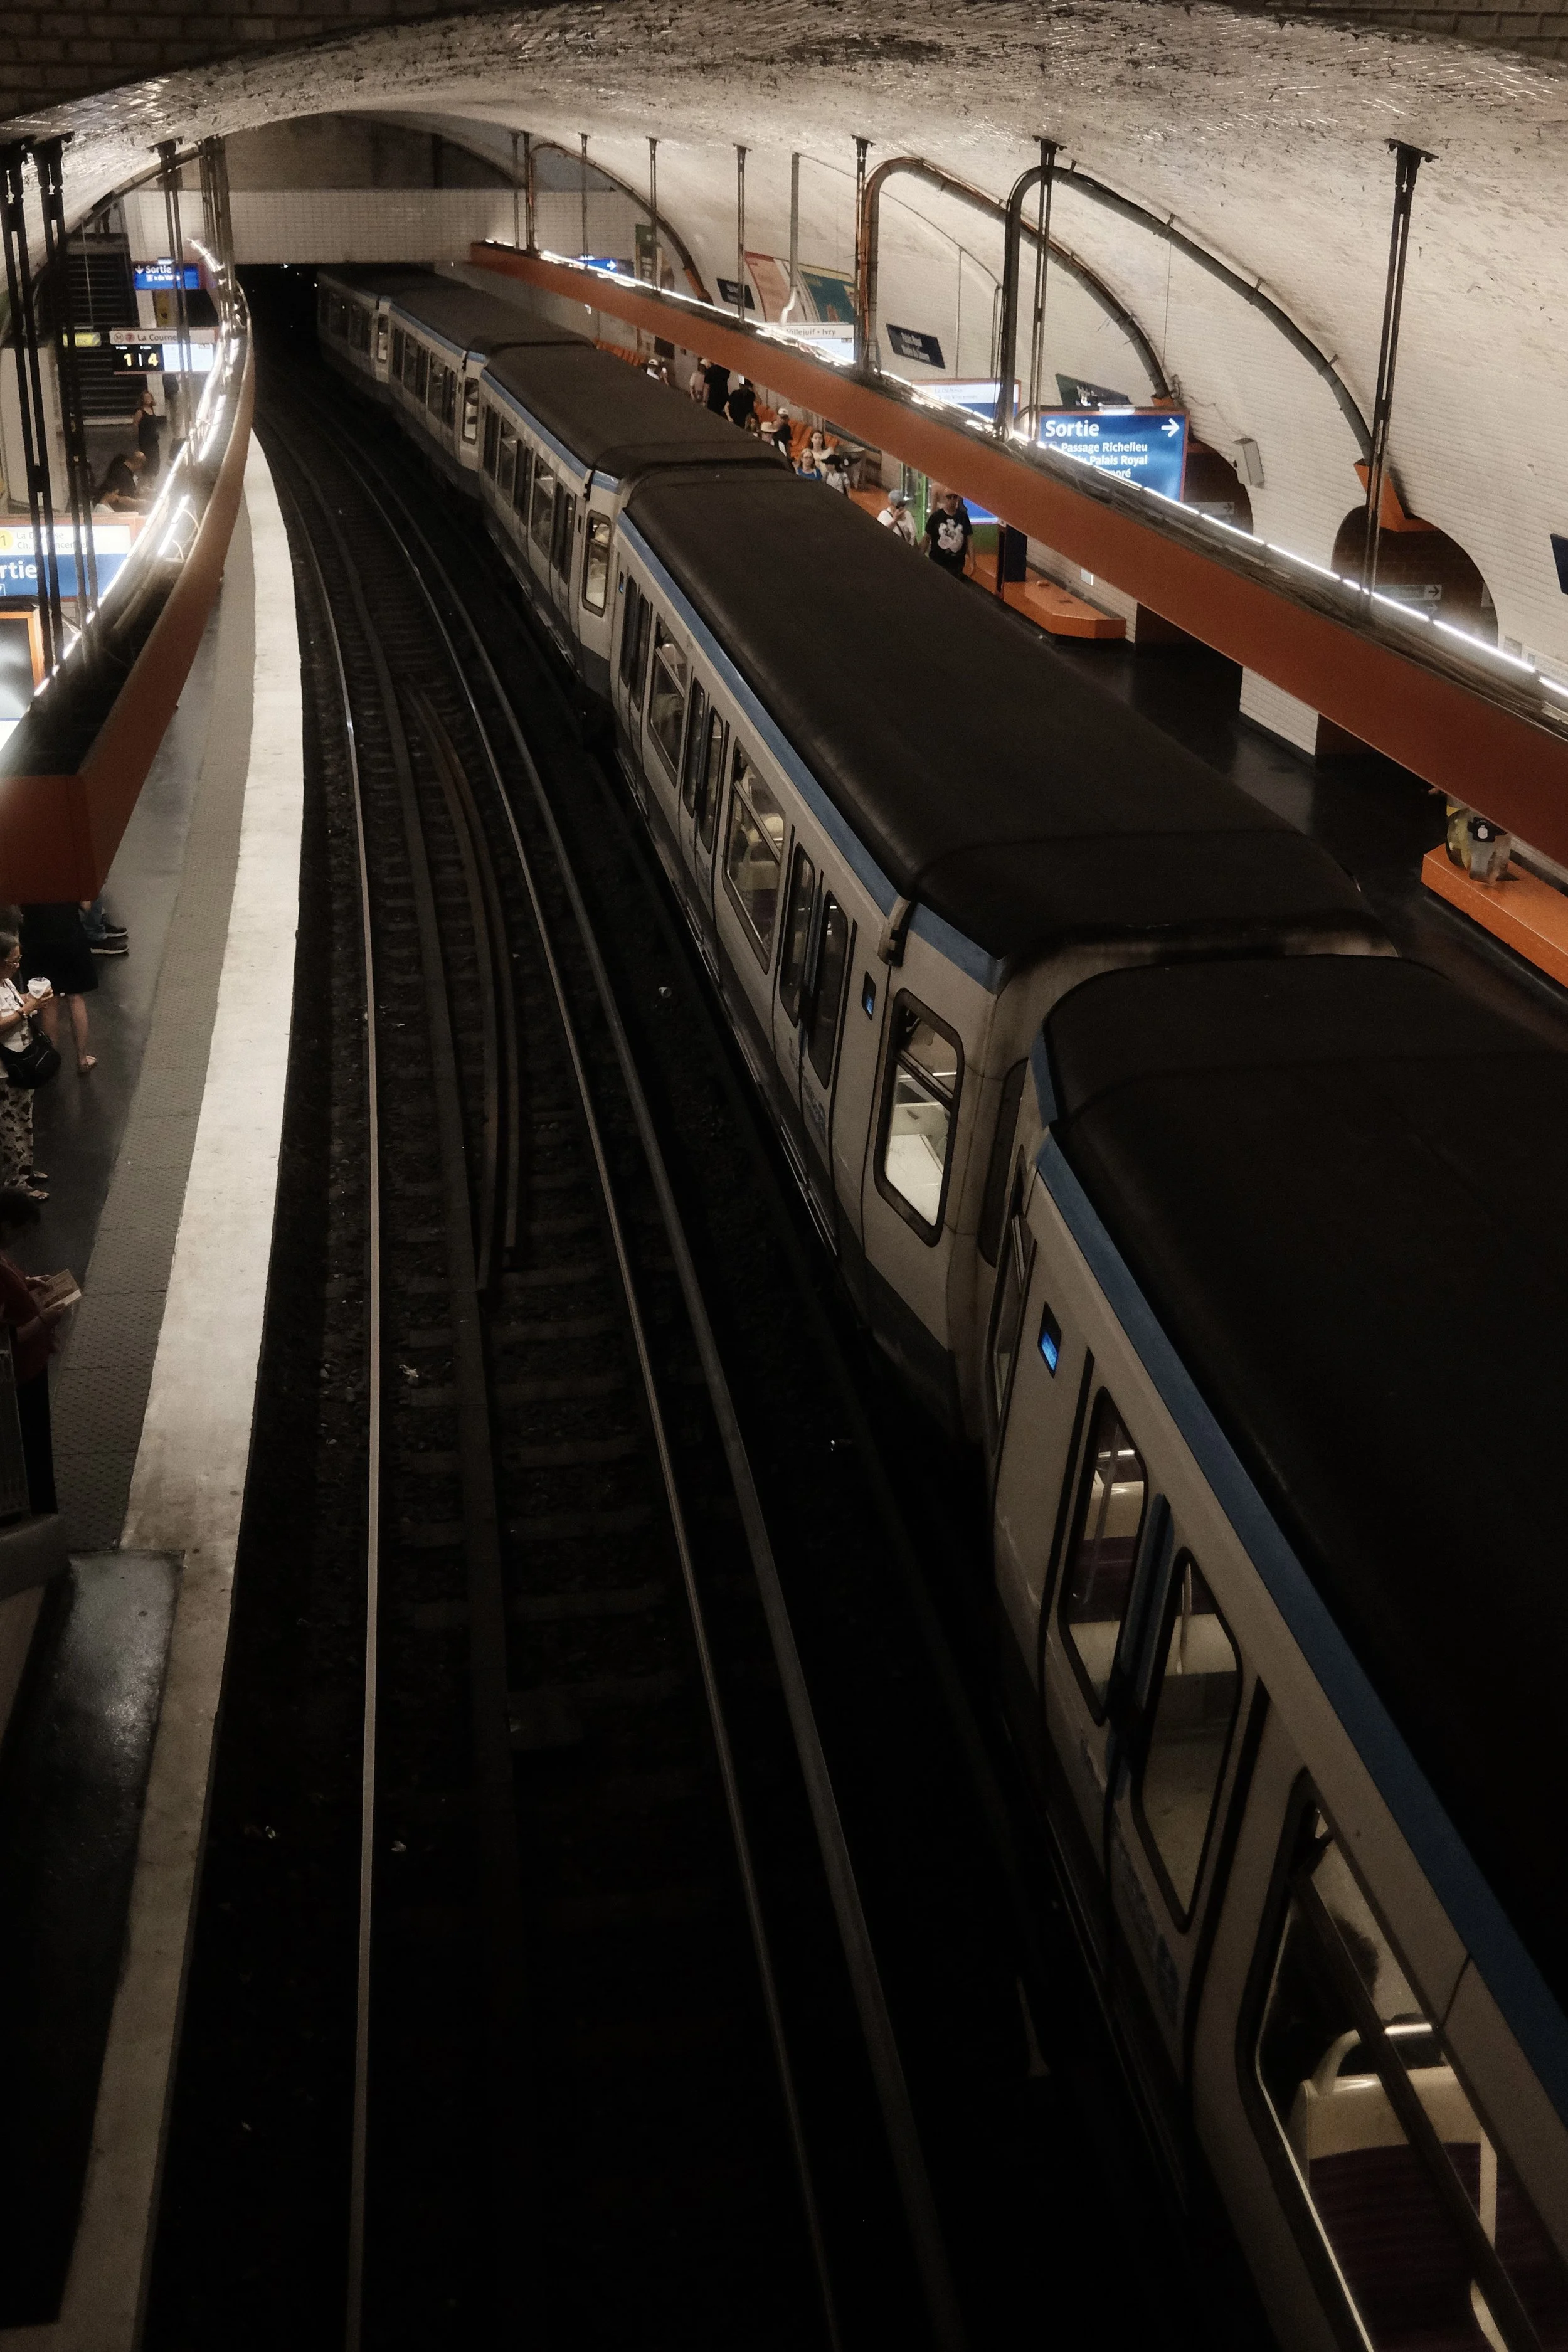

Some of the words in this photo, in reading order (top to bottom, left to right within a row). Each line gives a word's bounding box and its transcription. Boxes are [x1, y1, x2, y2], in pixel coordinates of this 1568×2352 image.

[146, 265, 172, 273] Sortie
[147, 352, 159, 366] 4
[1045, 420, 1099, 437] Sortie
[1061, 443, 1099, 454] Passage
[1103, 442, 1148, 452] Richelieu
[1089, 455, 1118, 465] Palais
[1120, 455, 1148, 467] Royal
[0, 560, 38, 578] rtie
